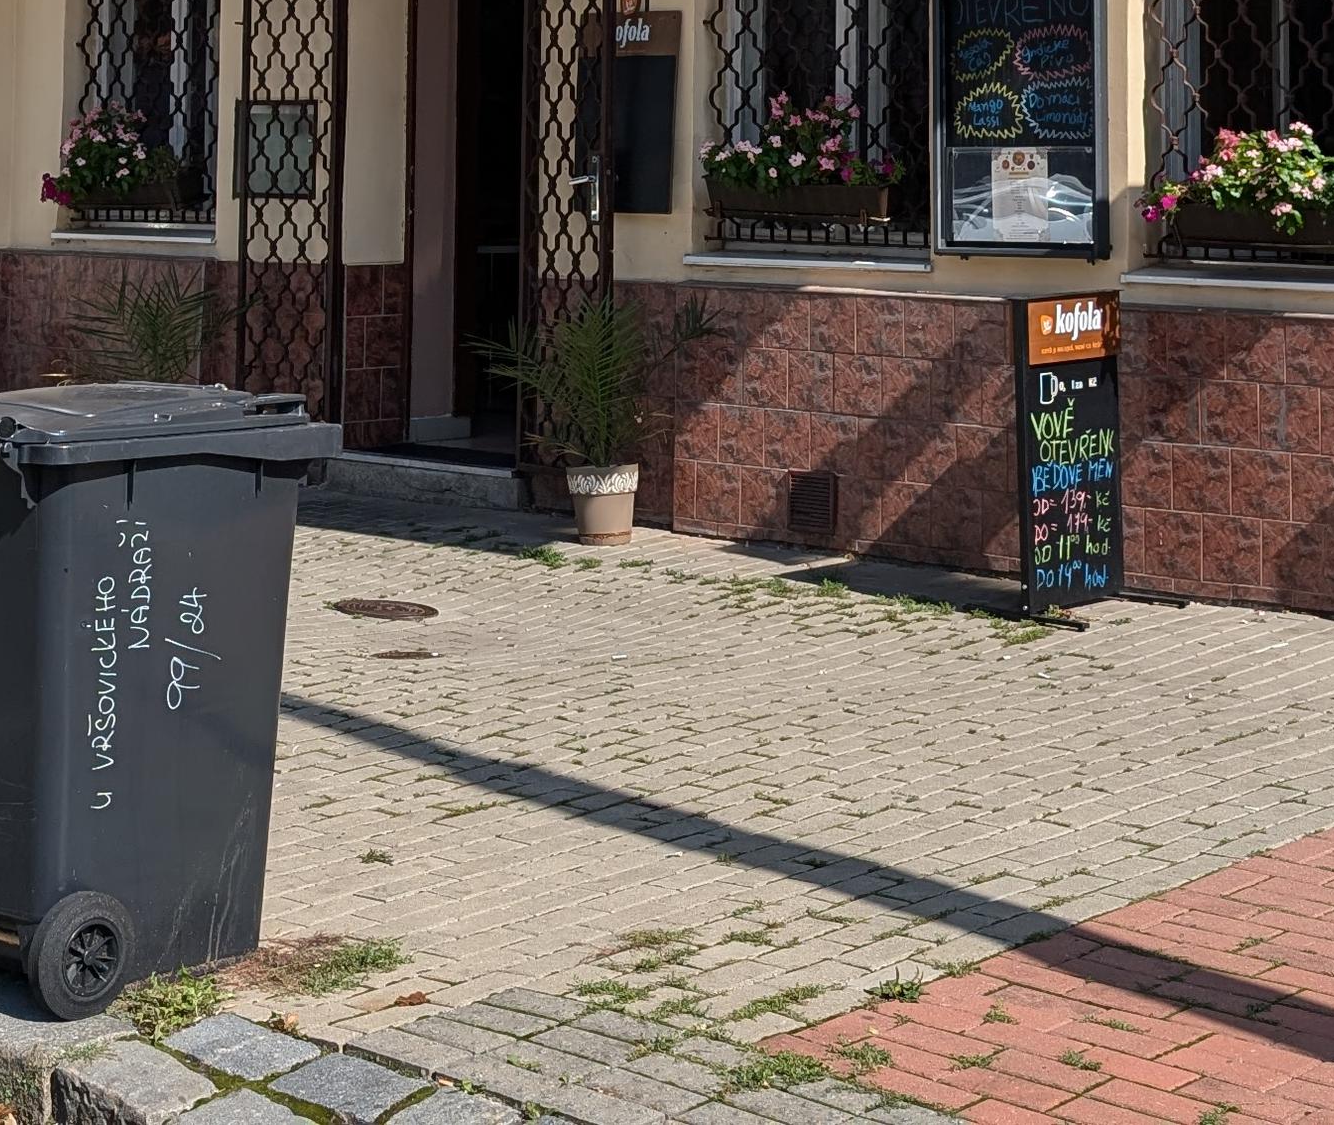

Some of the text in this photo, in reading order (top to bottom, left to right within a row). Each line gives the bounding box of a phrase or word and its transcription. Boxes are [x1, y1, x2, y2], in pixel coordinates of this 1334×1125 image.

[616, 18, 650, 49] ofola
[1055, 301, 1102, 341] kofola
[115, 518, 153, 650] NÁDRAŽÍ
[90, 791, 113, 811] U
